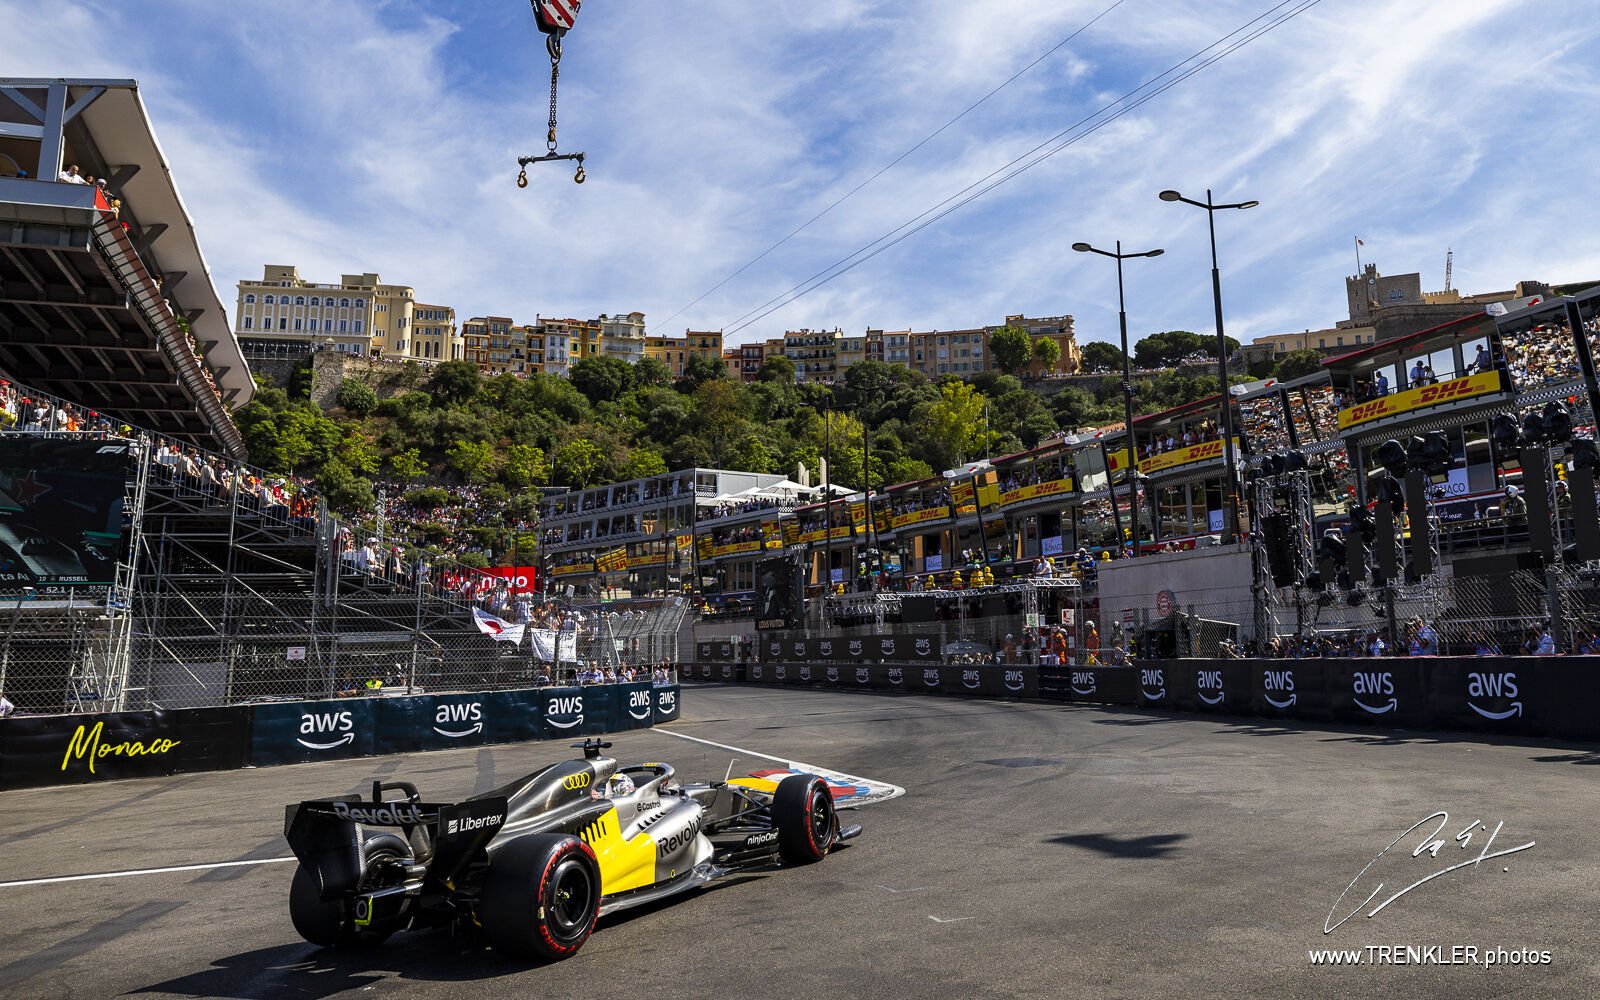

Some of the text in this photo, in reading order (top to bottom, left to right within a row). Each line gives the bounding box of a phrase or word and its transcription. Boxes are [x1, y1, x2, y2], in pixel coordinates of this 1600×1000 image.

[1420, 379, 1474, 403] DHL
[1351, 400, 1388, 422] DHL
[1188, 443, 1223, 459] DHL
[1034, 482, 1060, 495] DHL
[882, 640, 894, 648] aws
[916, 639, 930, 648] aws
[856, 668, 869, 677] aws
[889, 668, 902, 677] aws
[924, 669, 939, 679] aws
[963, 670, 980, 681] aws
[1005, 670, 1023, 682] aws
[1072, 672, 1095, 684] aws
[1141, 669, 1164, 686] aws
[1198, 670, 1223, 689] aws
[1264, 670, 1294, 691] aws
[1354, 672, 1394, 695] aws
[1468, 672, 1518, 698] aws
[548, 695, 583, 715] aws
[629, 689, 650, 708] aws
[659, 691, 675, 705] aws
[436, 702, 481, 723] aws
[300, 711, 353, 734] aws
[61, 721, 181, 774] Monaco
[332, 802, 423, 825] Revolut
[642, 801, 661, 811] Castrol
[460, 814, 502, 832] Libertex
[747, 832, 778, 846] ninjaOne
